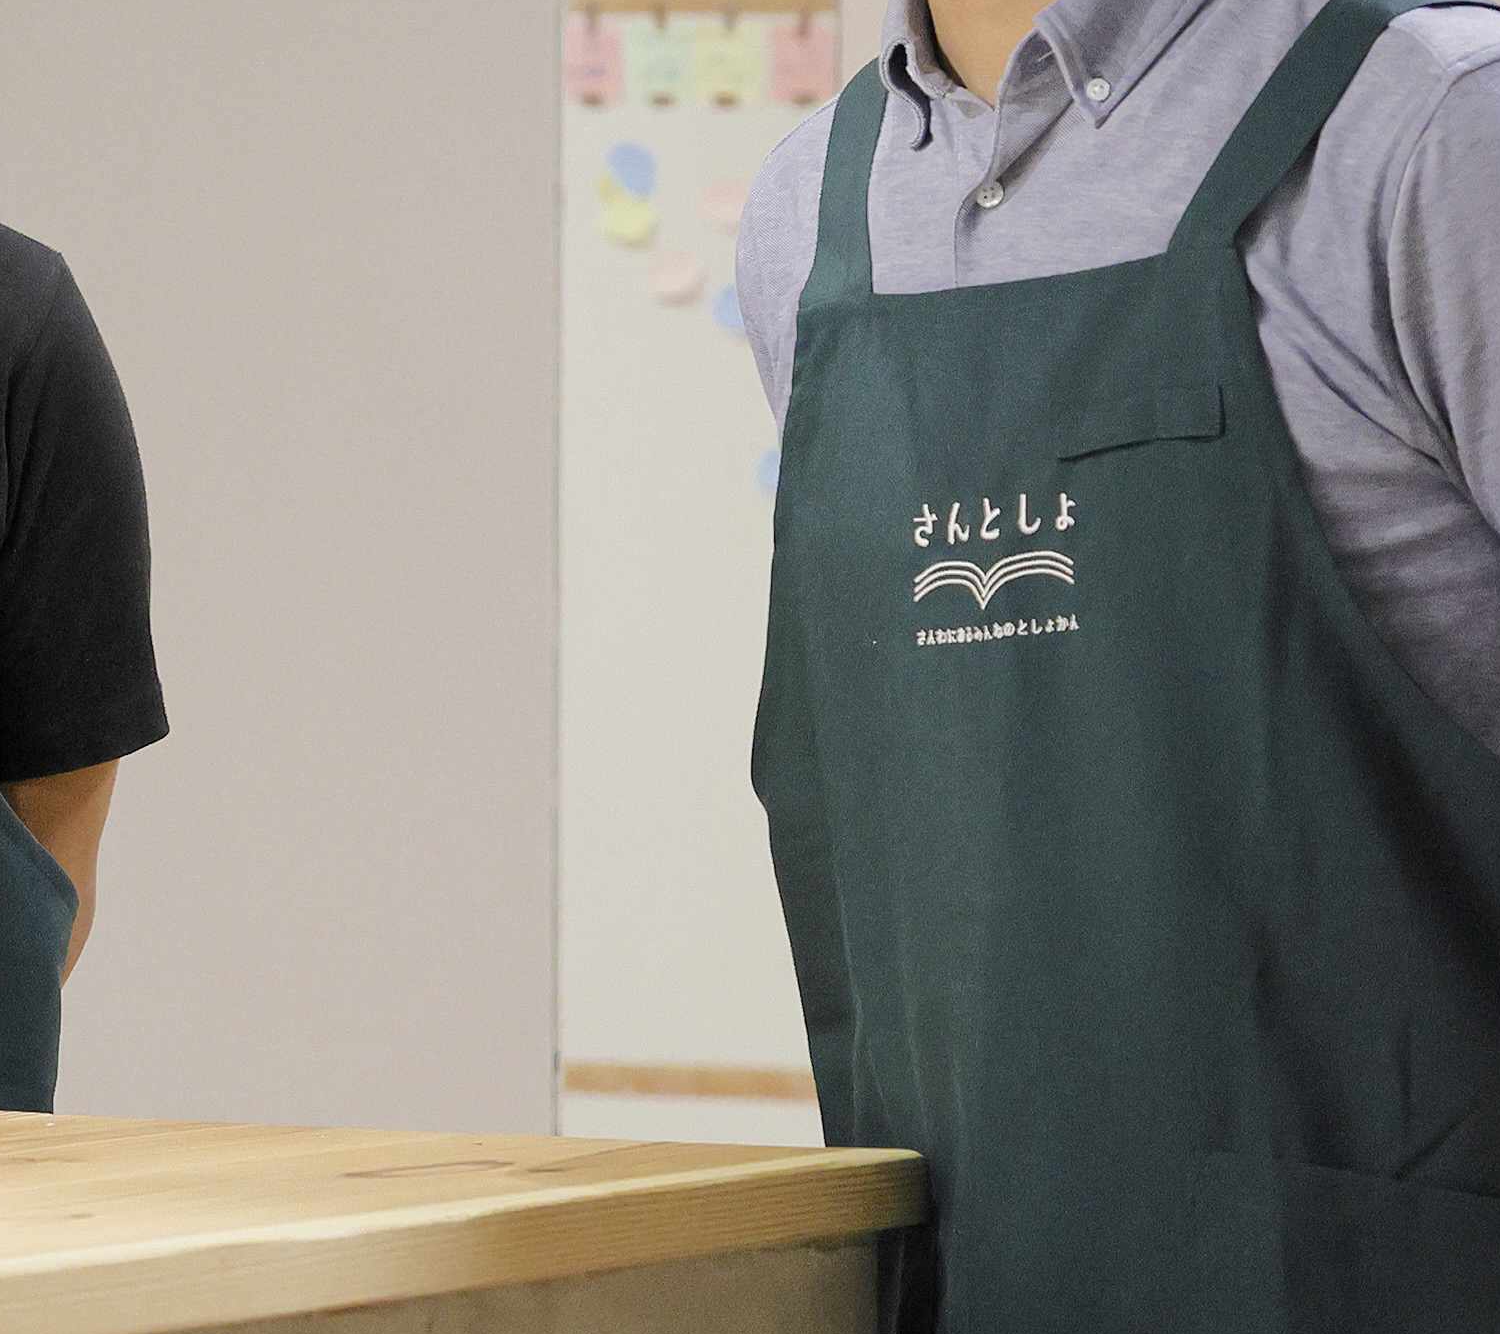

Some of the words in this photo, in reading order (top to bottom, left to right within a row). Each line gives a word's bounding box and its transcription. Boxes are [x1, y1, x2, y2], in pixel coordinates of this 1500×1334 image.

[913, 492, 1077, 548] さんとしょ
